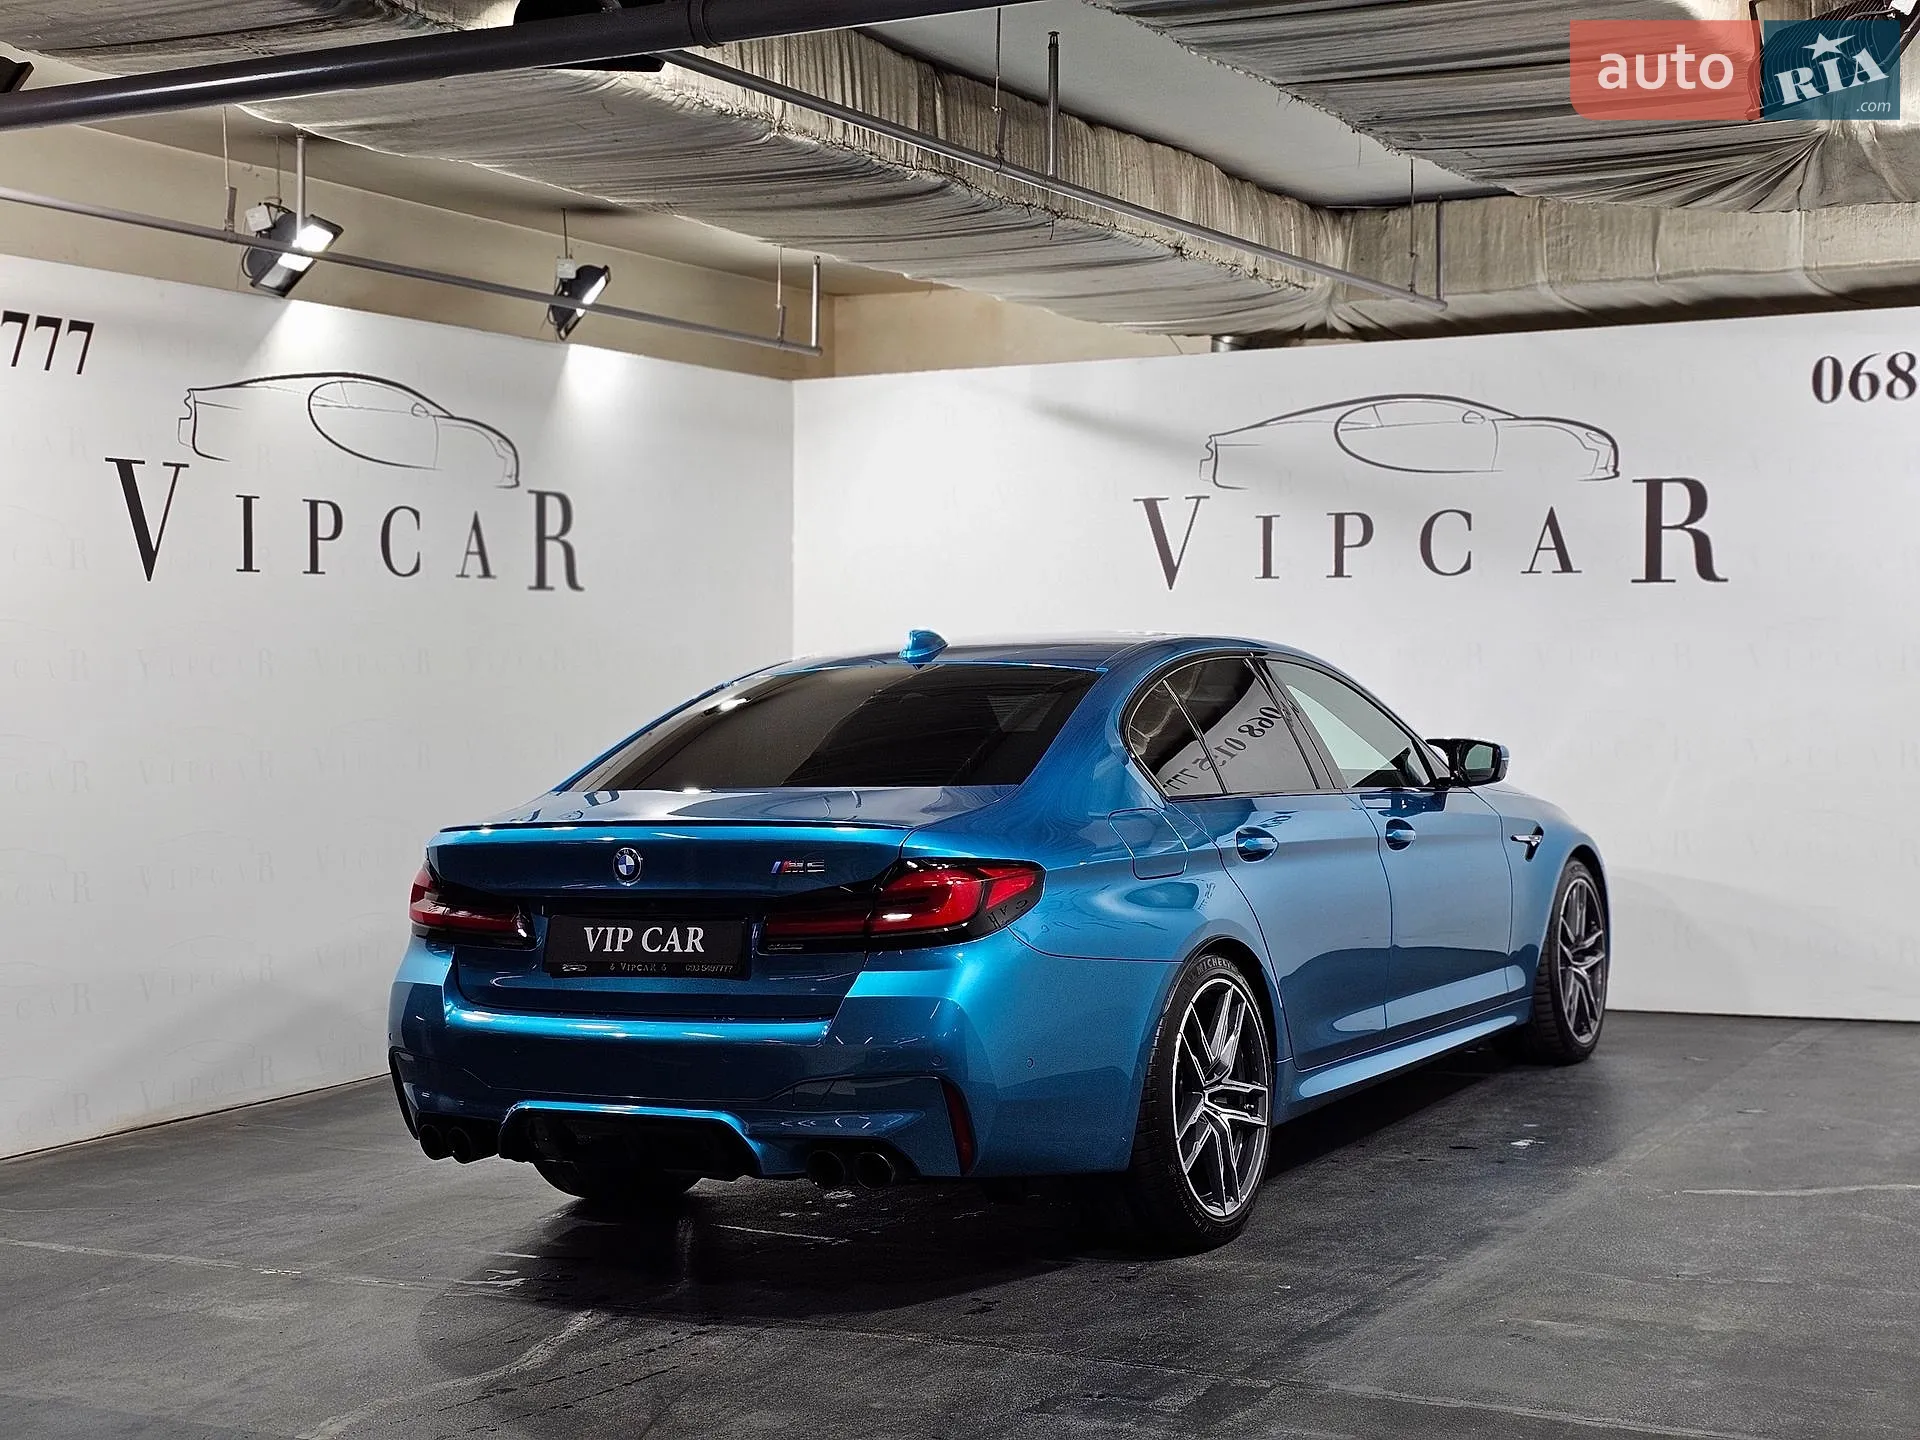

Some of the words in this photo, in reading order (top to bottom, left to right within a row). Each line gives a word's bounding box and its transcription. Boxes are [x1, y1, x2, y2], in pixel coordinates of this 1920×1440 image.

[1, 310, 95, 375] 777
[1812, 351, 1917, 404] 068
[105, 457, 584, 592] VIPCAR
[1133, 477, 1729, 591] VIPCAR
[583, 926, 634, 953] VIP
[641, 926, 705, 953] CAR
